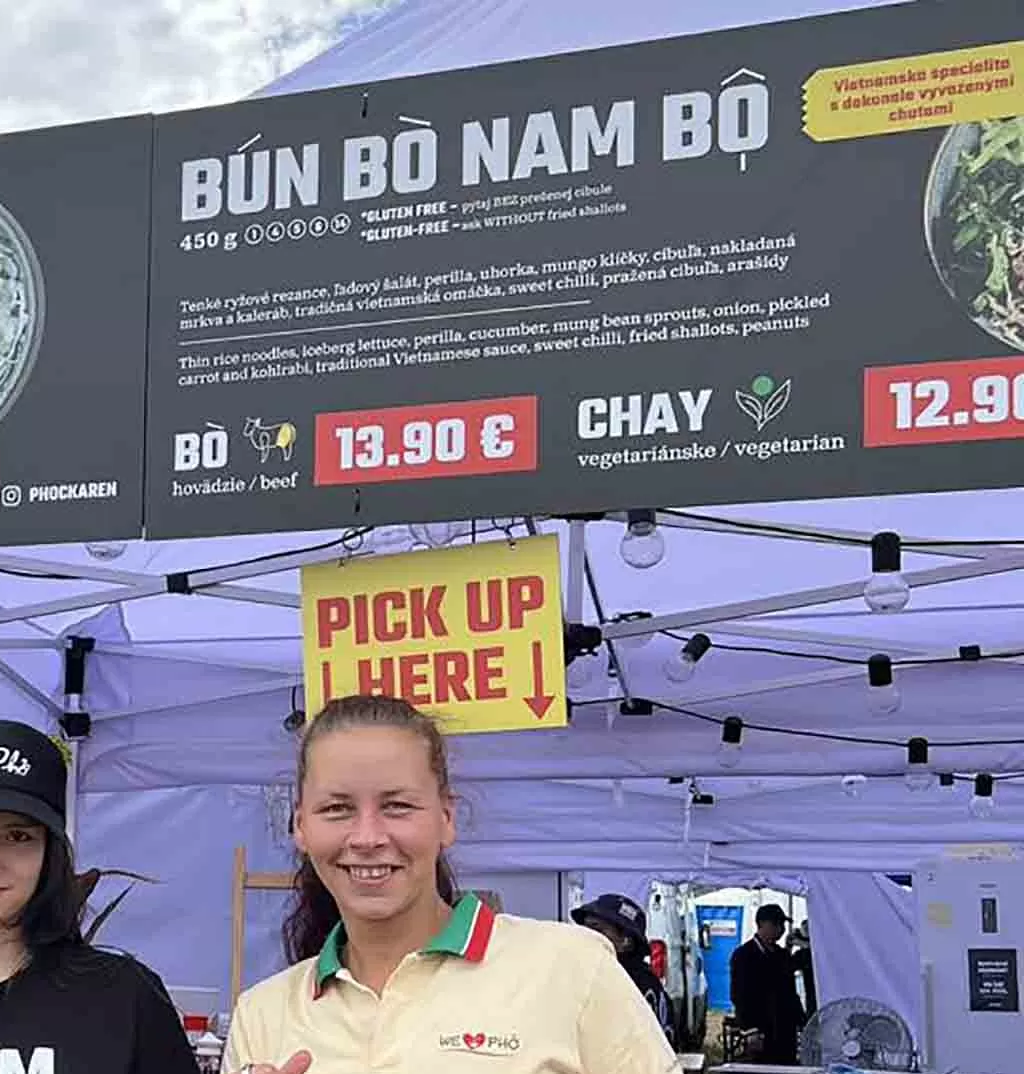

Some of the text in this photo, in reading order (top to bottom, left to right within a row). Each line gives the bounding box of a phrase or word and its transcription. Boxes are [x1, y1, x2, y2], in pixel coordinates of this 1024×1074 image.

[830, 101, 838, 111] s
[842, 87, 915, 109] dokonale
[181, 67, 769, 222] BÚN BÒ NAM BỘ
[416, 201, 448, 216] FREE
[575, 184, 613, 198] cibule
[483, 210, 546, 227] WITHOUT
[547, 207, 576, 221] fried
[579, 202, 626, 217] shallots
[180, 231, 219, 250] 450
[223, 231, 238, 250] g
[179, 297, 221, 313] Tenké
[224, 290, 270, 311] ryžové
[273, 287, 331, 303] rezance,
[425, 269, 477, 289] perilla,
[480, 263, 539, 281] uhorka,
[542, 257, 597, 274] mungo
[710, 232, 796, 256] nakladaná
[179, 315, 223, 329] mrkva
[226, 315, 234, 325] a
[295, 300, 353, 317] tradičná
[356, 292, 441, 310] vietnamská
[443, 283, 505, 301] omáčka,
[508, 279, 553, 295] sweet
[555, 273, 600, 290] chilli,
[602, 267, 666, 289] pražená
[178, 292, 831, 369] Thin rice noodles, iceberg lettuce, perilla, cucumber, mung bean sprouts, onion, pickled
[178, 315, 810, 386] carrot and kohlrabi, traditional Vietnamese sauce, sweet chilli, fried shallots, peanuts
[576, 389, 714, 441] CHAY
[173, 422, 228, 472] BÒ
[334, 414, 516, 471] 13.90 €
[577, 444, 717, 471] vegetariánske
[733, 434, 846, 461] vegetarian
[29, 481, 118, 503] PHOCKAREN
[260, 473, 299, 491] beef
[316, 575, 545, 649] PICK UP
[357, 646, 509, 707] HERE
[439, 1033, 462, 1047] WE
